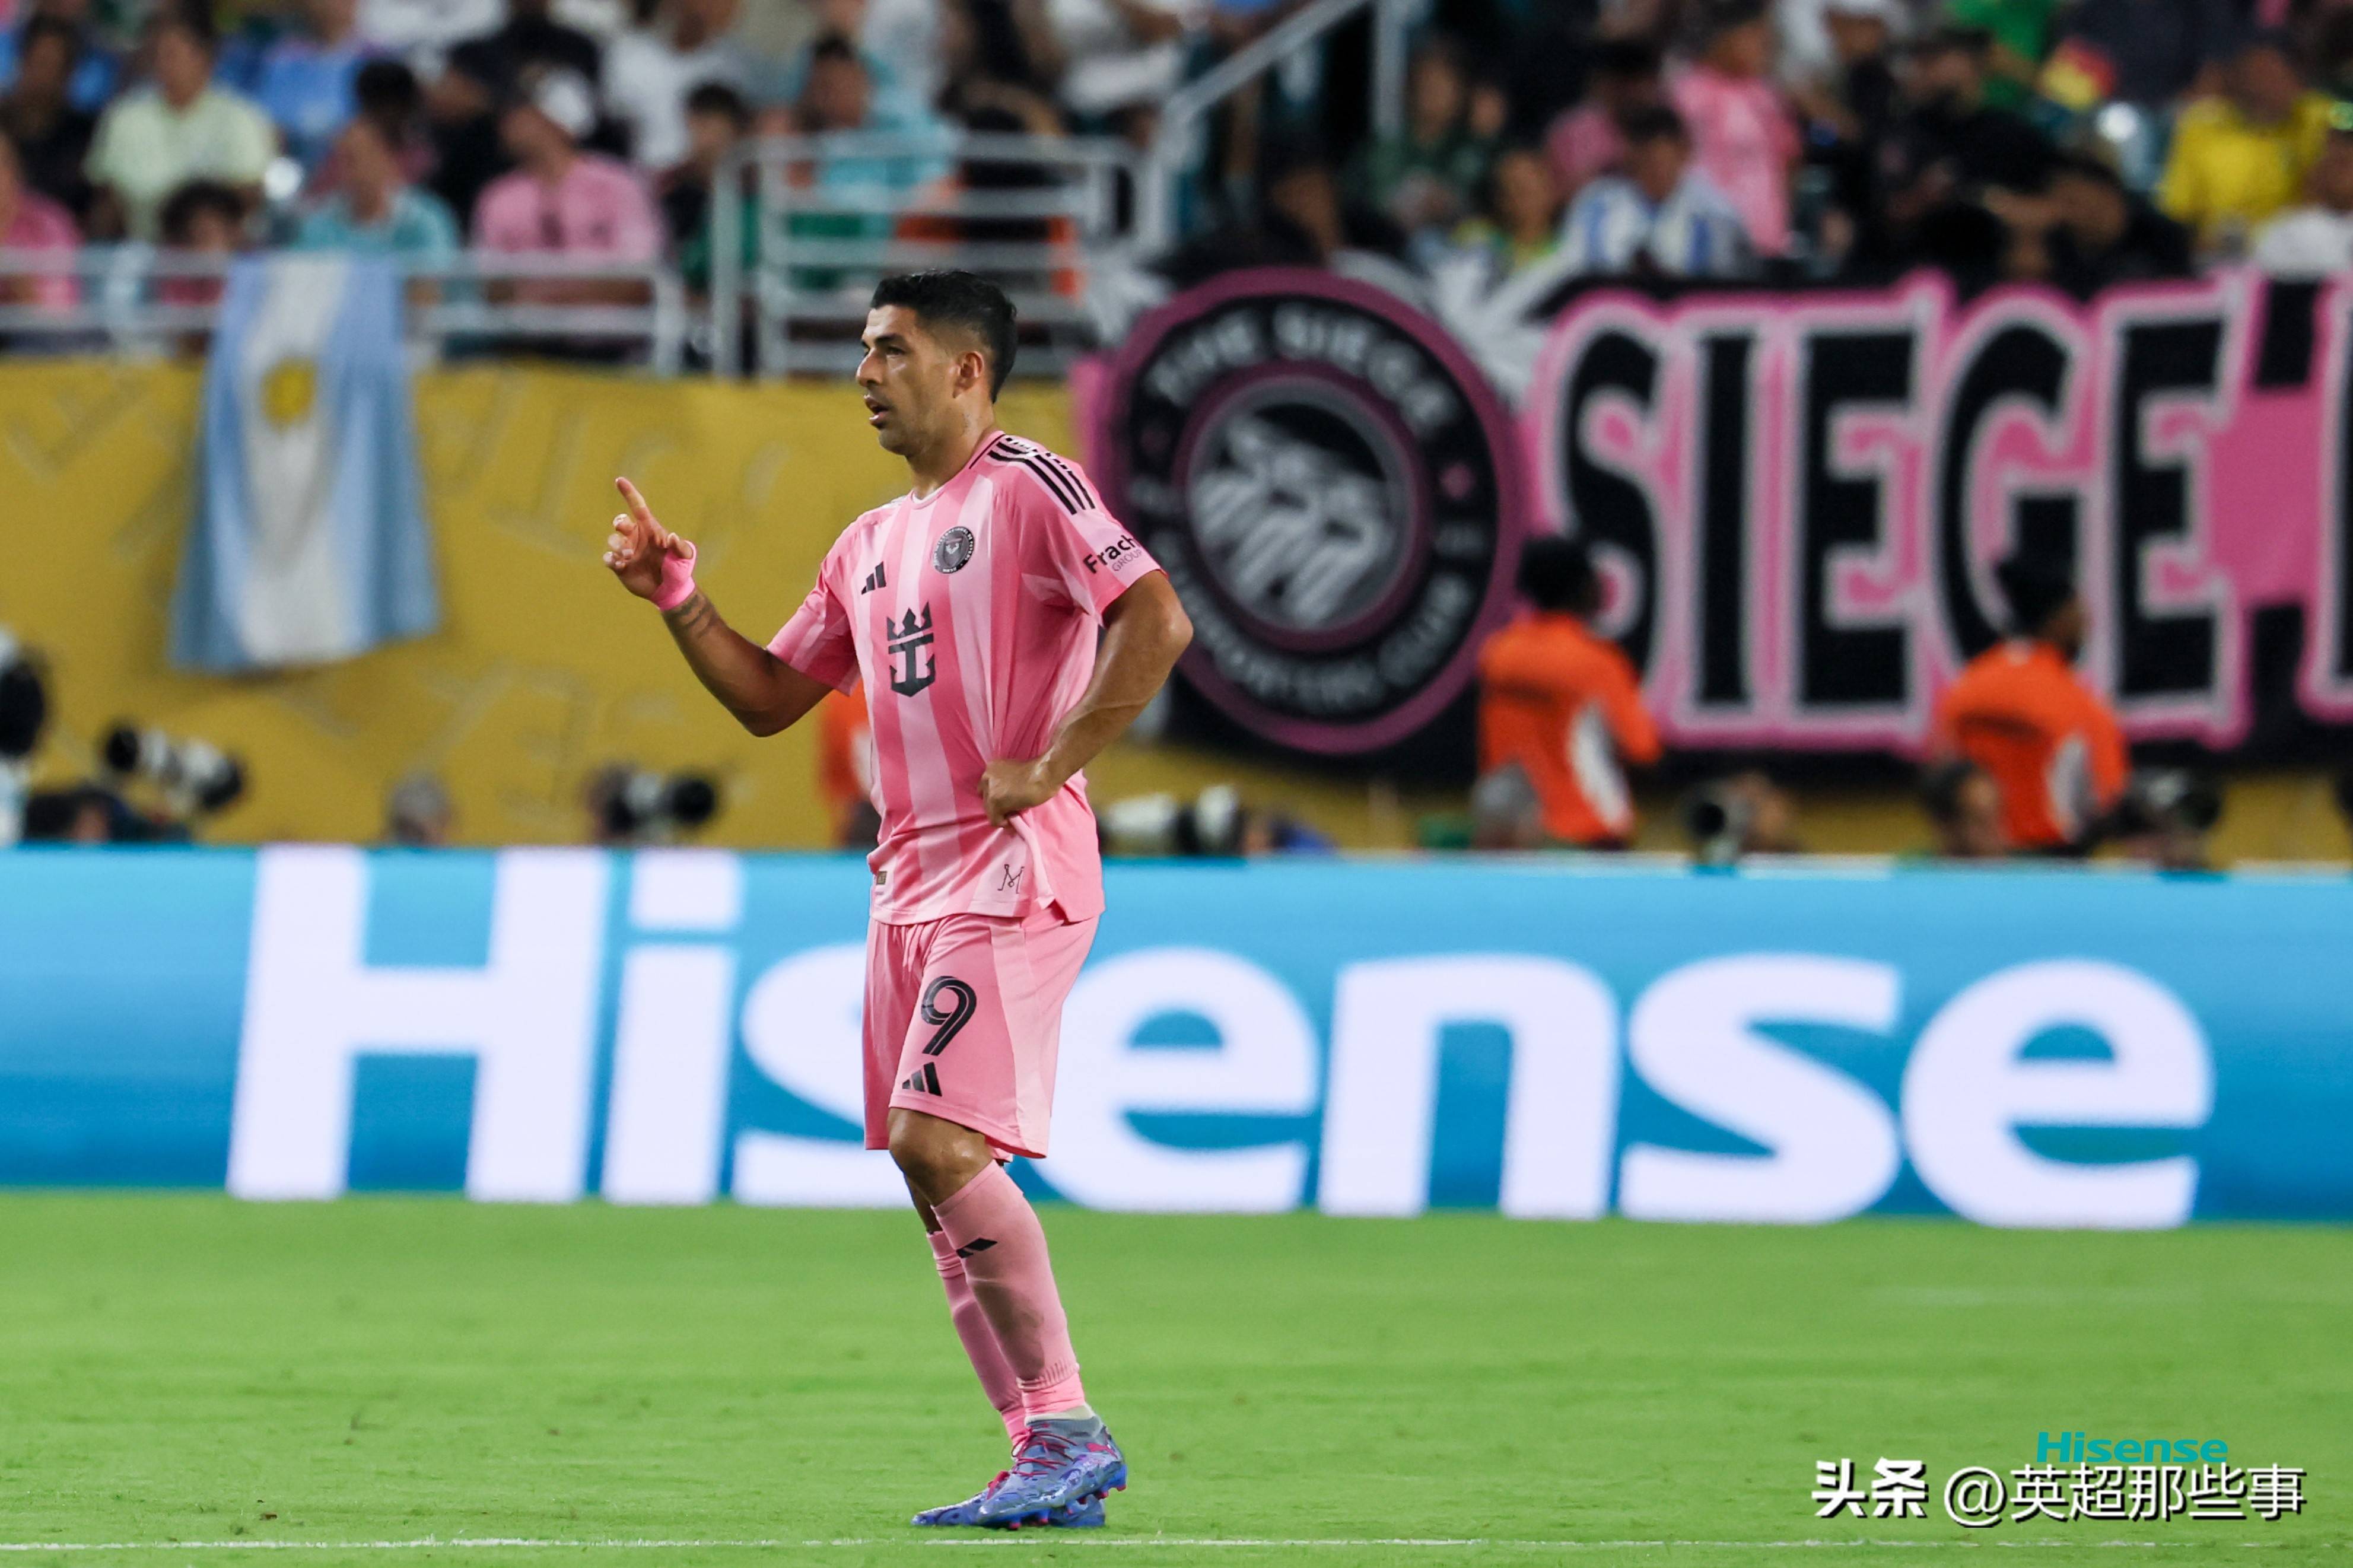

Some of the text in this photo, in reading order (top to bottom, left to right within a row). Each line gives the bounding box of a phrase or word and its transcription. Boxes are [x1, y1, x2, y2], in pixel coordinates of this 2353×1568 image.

[1271, 303, 1461, 439] SIEGE
[1546, 297, 2243, 733] SIEGE
[229, 845, 2207, 1228] Hisense
[921, 975, 977, 1057] 9
